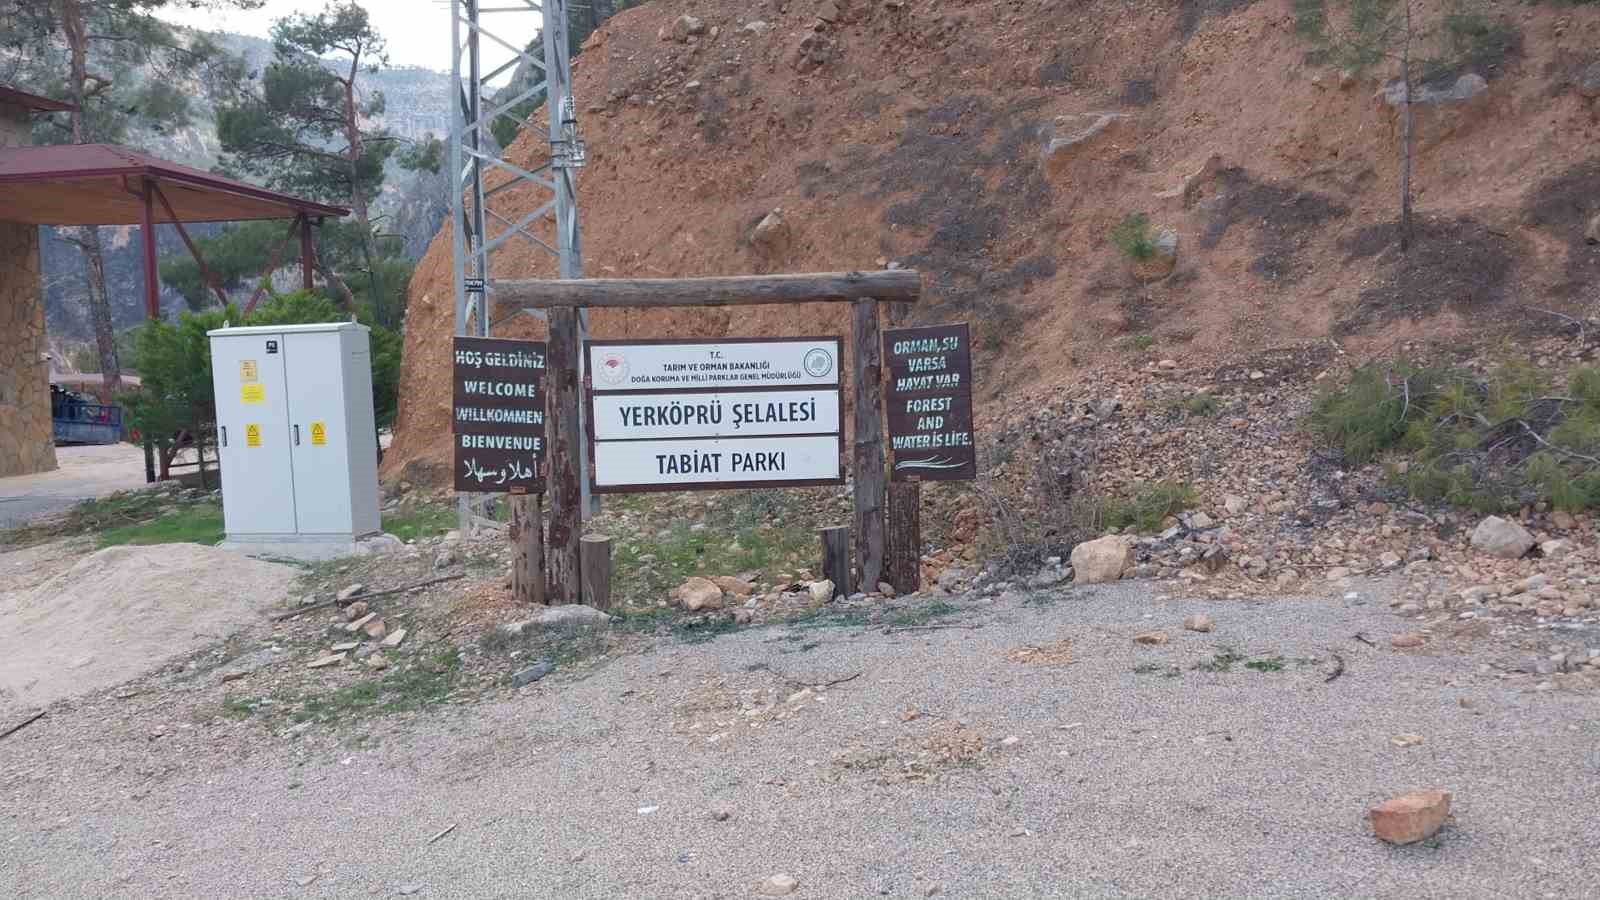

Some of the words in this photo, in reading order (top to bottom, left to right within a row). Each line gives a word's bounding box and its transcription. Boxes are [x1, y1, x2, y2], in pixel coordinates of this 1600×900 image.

[455, 350, 482, 368] HOŞ
[485, 351, 544, 368] GELDİNİZ
[710, 351, 723, 359] T.C.
[664, 363, 686, 372] TARIM
[688, 363, 698, 371] VE
[699, 362, 728, 371] ORMAN
[729, 360, 770, 370] BAKANLIĞI
[908, 356, 946, 373] VARSA
[631, 374, 651, 383] DOĞA
[652, 374, 680, 383] KORUMA
[681, 374, 690, 382] VE
[691, 373, 708, 383] MİLLİ
[708, 373, 738, 382] PARKLAR
[740, 373, 761, 381] GENEL
[762, 370, 801, 380] MÜDÜRLÜĞÜ
[896, 375, 934, 391] HAYAT
[935, 373, 960, 388] VAR
[464, 381, 535, 397] WELCOME
[619, 400, 722, 427] YERKÖPRÜ
[732, 397, 816, 429] ŞELALESİ
[906, 397, 952, 413] FOREST
[456, 407, 542, 424] WILLKOMMEN
[917, 416, 944, 430] AND
[462, 434, 541, 450] BIENVENUE
[893, 434, 930, 449] WATER
[656, 449, 722, 474] TABİAT
[731, 451, 785, 473] PARKI
